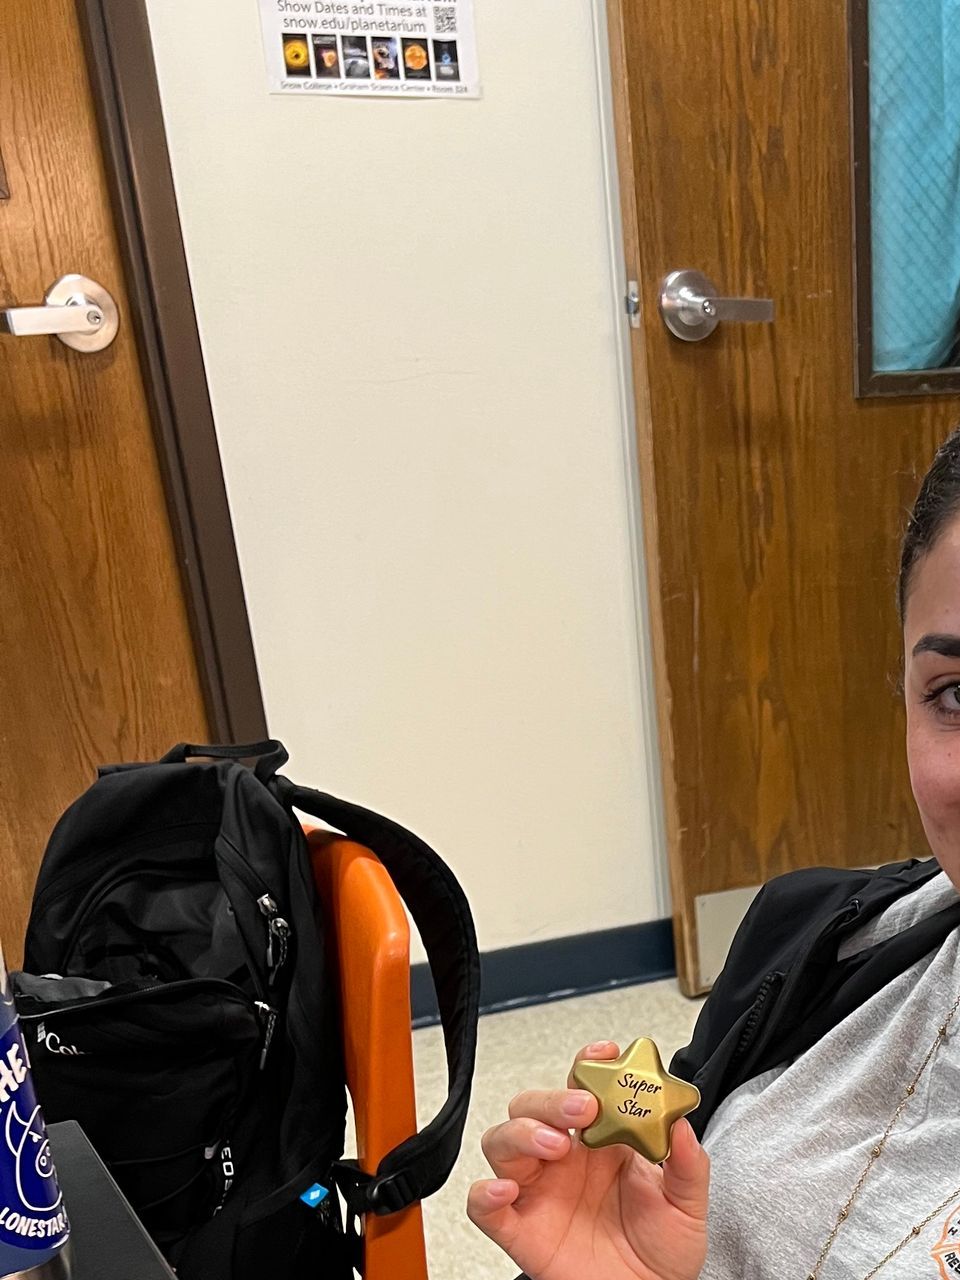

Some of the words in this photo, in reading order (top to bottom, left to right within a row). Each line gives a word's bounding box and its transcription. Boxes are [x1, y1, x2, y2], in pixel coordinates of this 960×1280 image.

[277, 0, 311, 12] Show
[315, 2, 349, 14] Dates
[352, 3, 373, 15] and
[376, 4, 412, 17] Times
[416, 6, 427, 17] at
[283, 17, 426, 34] snow.edu/planetarium
[617, 1073, 662, 1099] Super
[617, 1100, 652, 1118] Star
